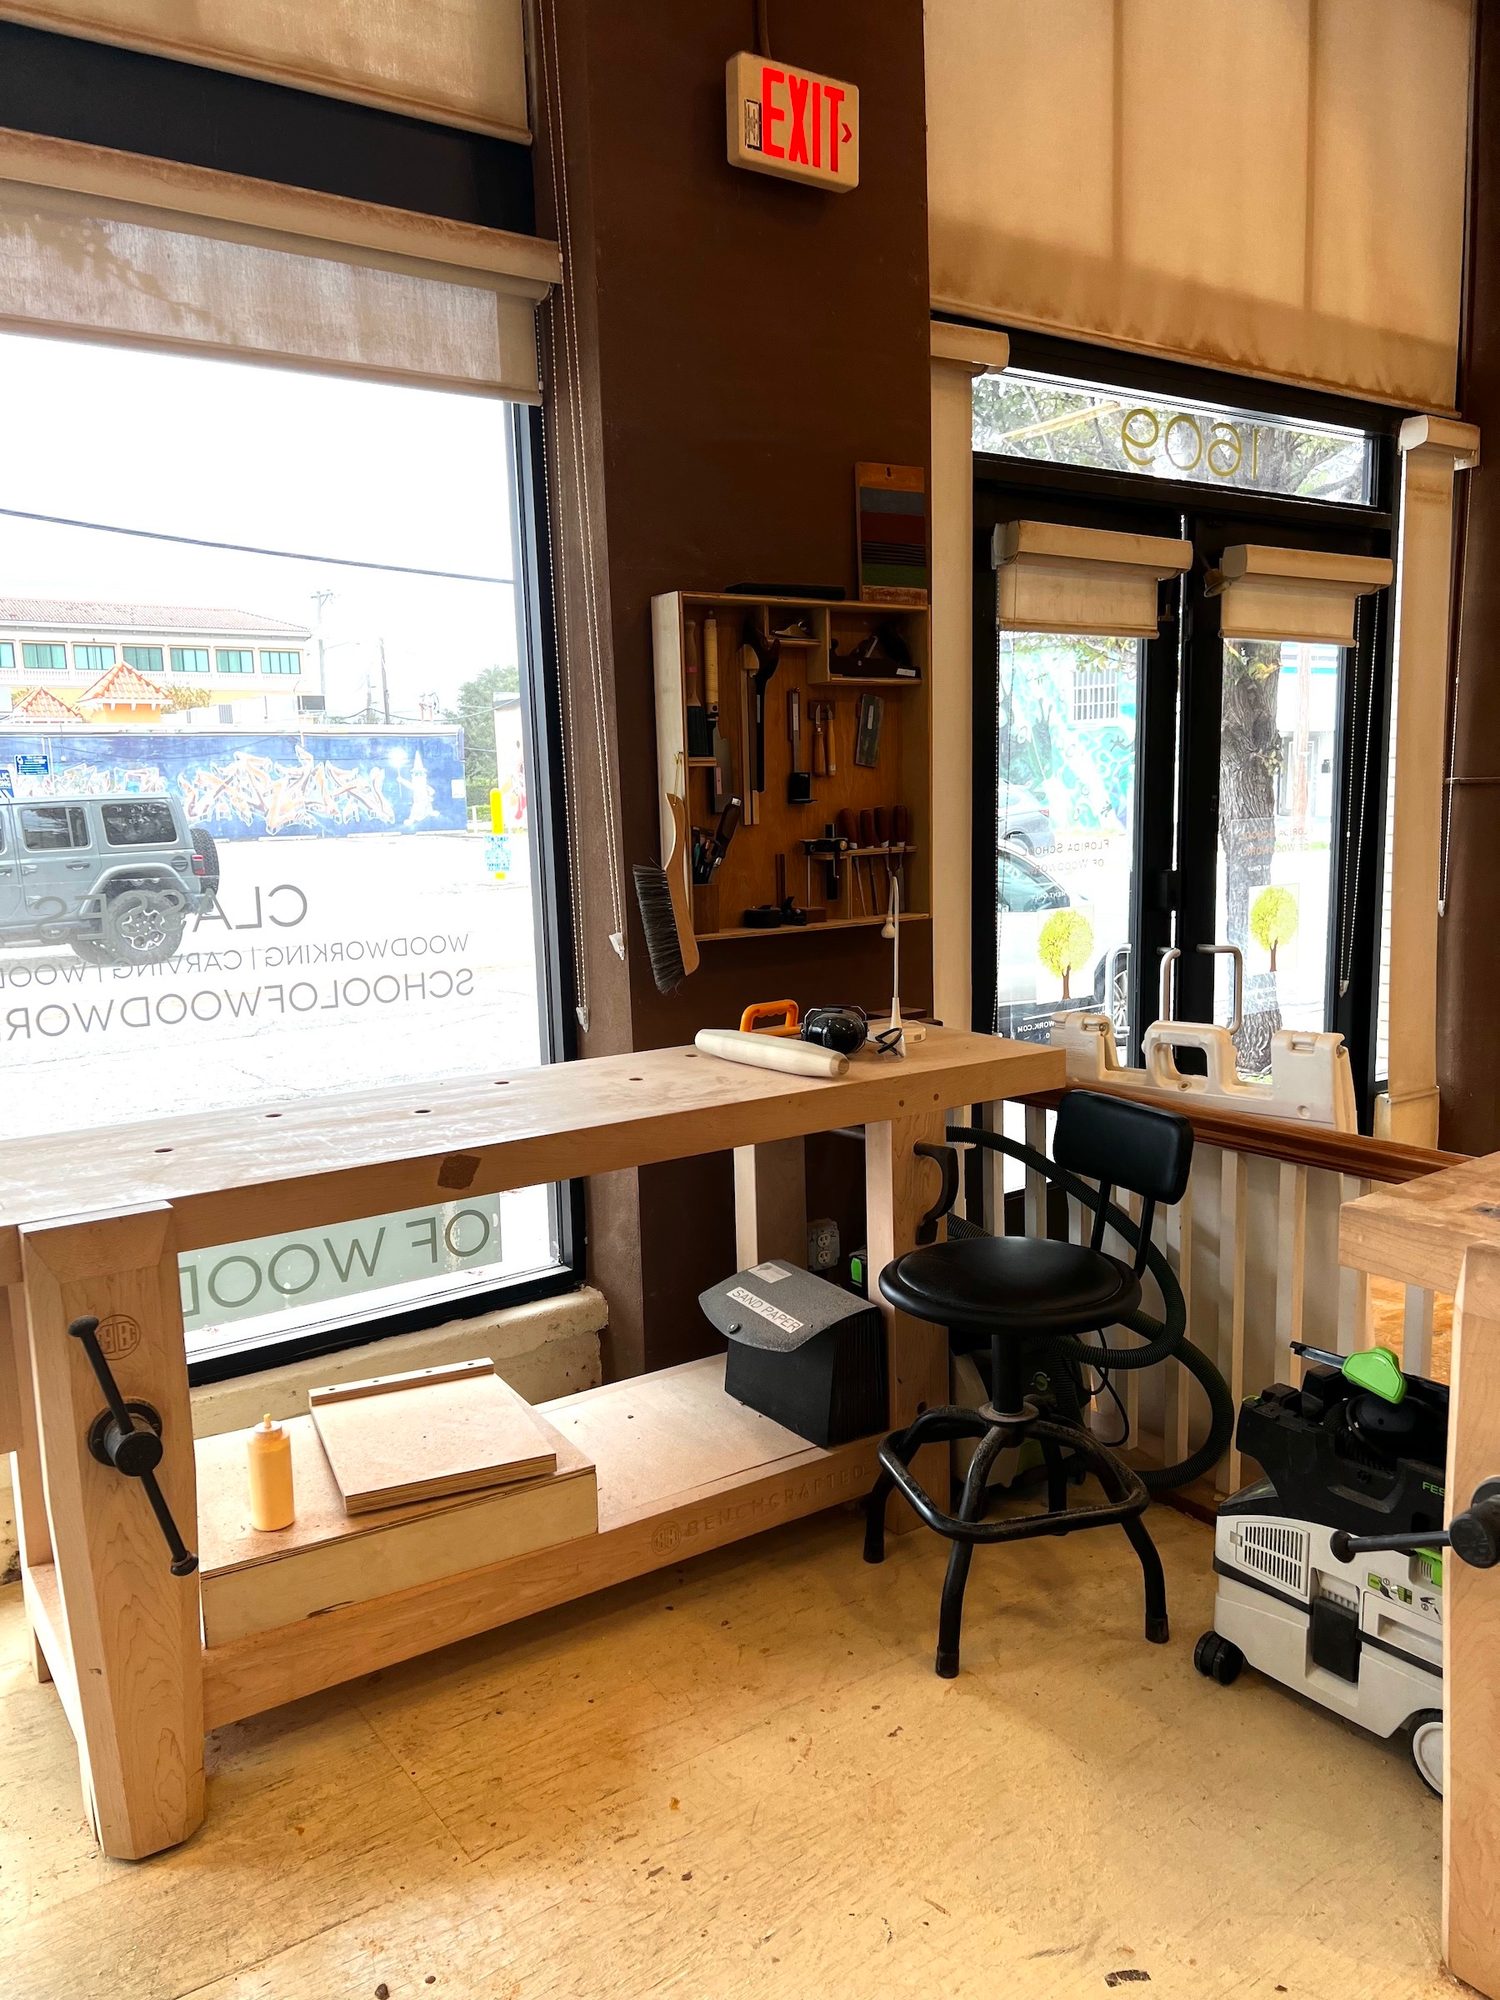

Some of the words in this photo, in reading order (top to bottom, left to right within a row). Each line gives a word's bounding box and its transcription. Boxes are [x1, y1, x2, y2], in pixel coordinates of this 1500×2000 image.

[762, 67, 845, 173] EXIT
[731, 1288, 764, 1310] SAND
[761, 1305, 802, 1332] PAPER
[1422, 1481, 1445, 1497] FES
